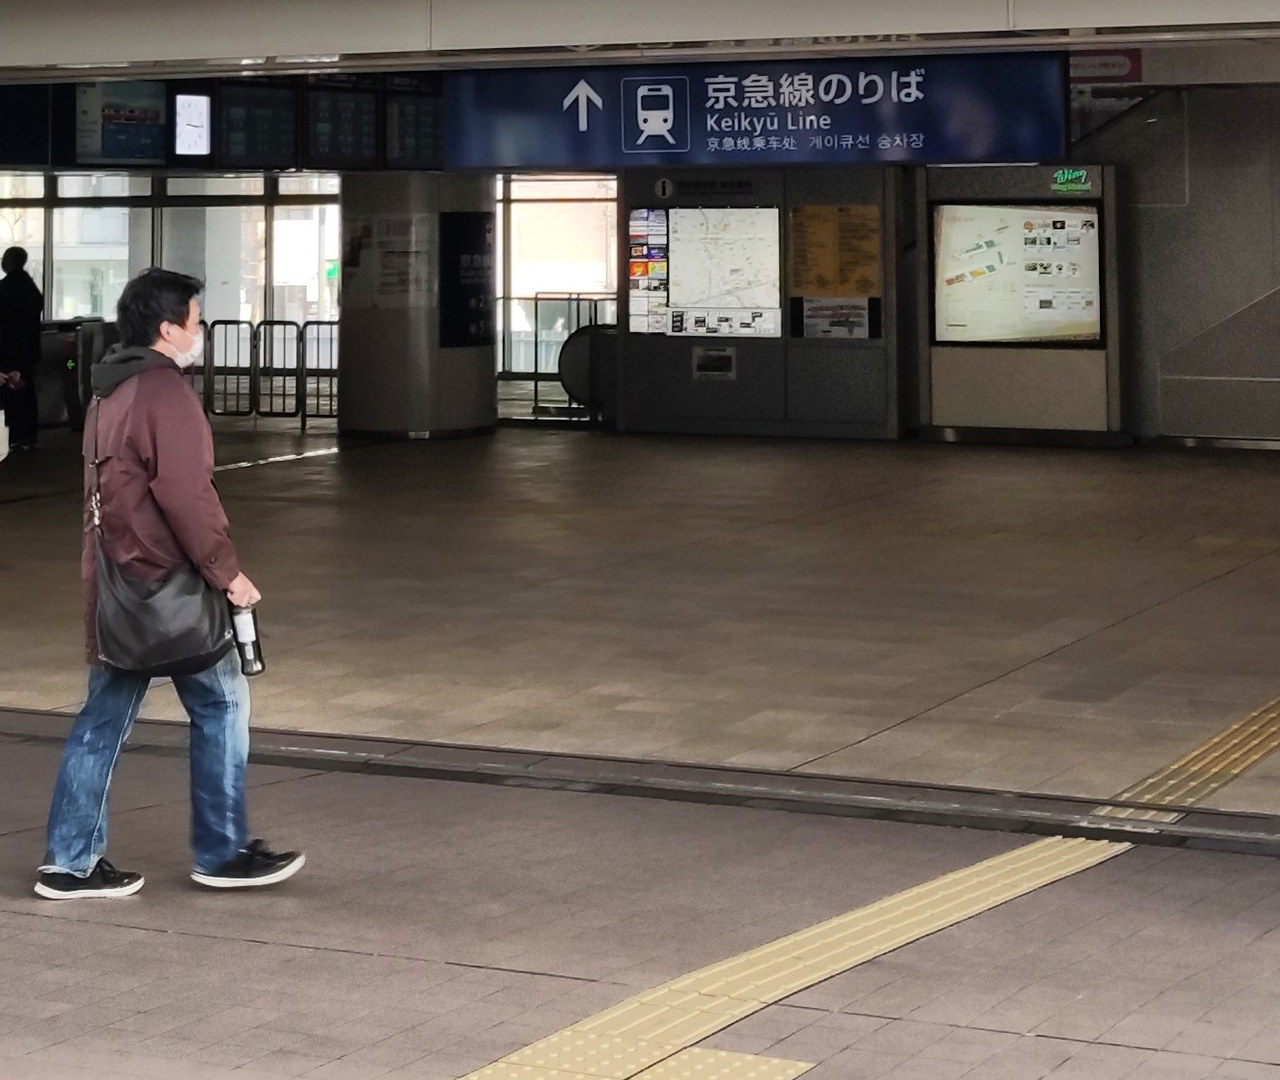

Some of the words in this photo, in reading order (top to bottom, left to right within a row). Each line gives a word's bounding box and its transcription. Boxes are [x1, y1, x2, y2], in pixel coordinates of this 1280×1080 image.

[704, 69, 925, 109] 京急線のりば
[706, 112, 778, 135] Keikyū
[787, 111, 831, 131] Line
[877, 132, 925, 149] 승차장
